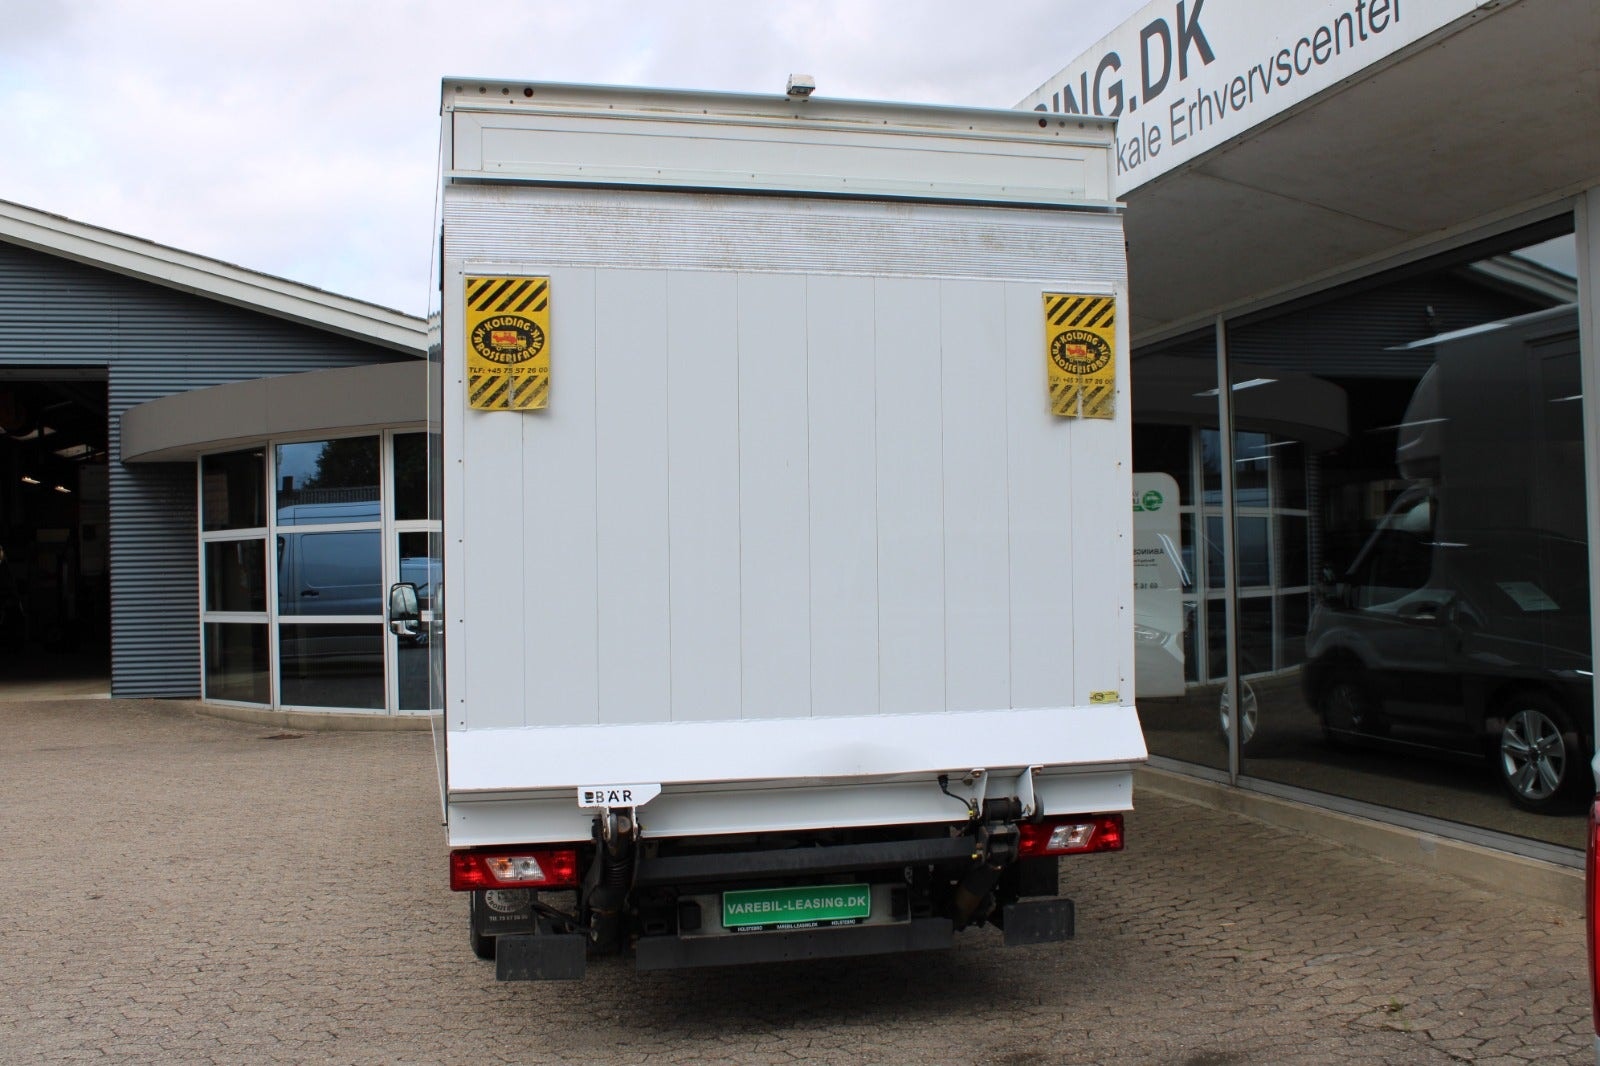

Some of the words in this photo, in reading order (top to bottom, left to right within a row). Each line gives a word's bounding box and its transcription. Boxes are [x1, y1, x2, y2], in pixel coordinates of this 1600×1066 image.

[1033, 0, 1215, 118] NG.DK
[484, 316, 532, 332] KOLDING
[1060, 331, 1099, 346] KOLDING
[469, 366, 486, 374] TLF:
[487, 366, 502, 374] +45
[515, 366, 525, 374] 57
[538, 366, 549, 374] 00
[595, 789, 633, 804] BÄR
[727, 895, 866, 915] VAREBIL-LEASING.DK
